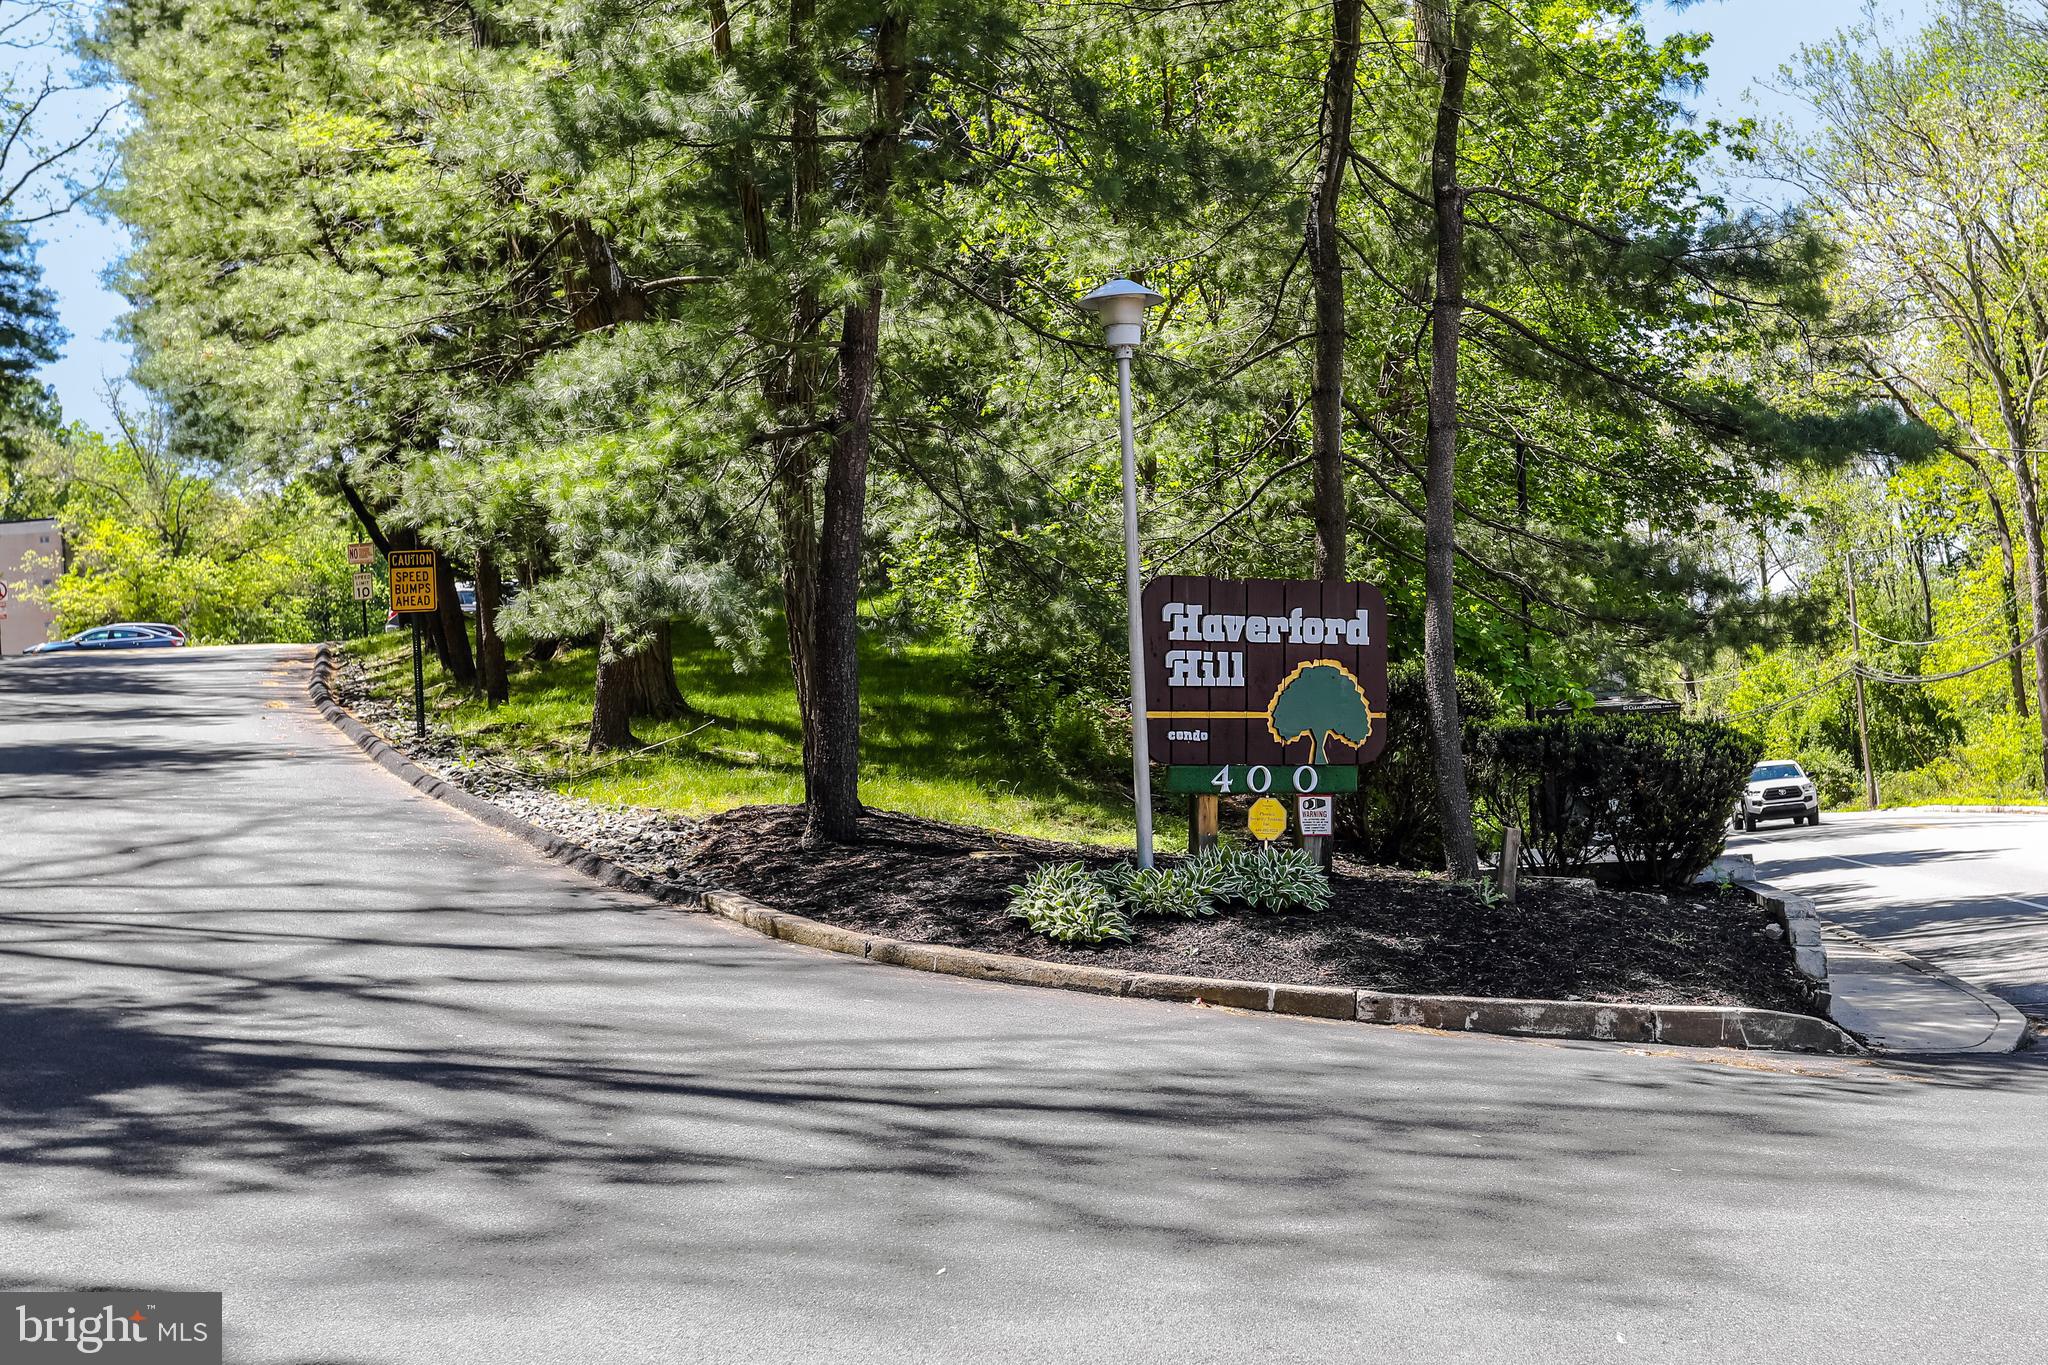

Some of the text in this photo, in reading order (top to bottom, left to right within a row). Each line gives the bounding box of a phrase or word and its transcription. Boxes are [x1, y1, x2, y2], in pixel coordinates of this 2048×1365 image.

[350, 548, 359, 559] NO
[392, 554, 432, 566] CAUTION
[396, 571, 429, 582] SPEED
[357, 587, 370, 598] 10
[395, 583, 431, 595] BUMPS
[396, 595, 431, 607] AHEAD
[1162, 602, 1370, 646] Haverford
[1165, 650, 1245, 687] Hill
[1168, 730, 1208, 742] condo
